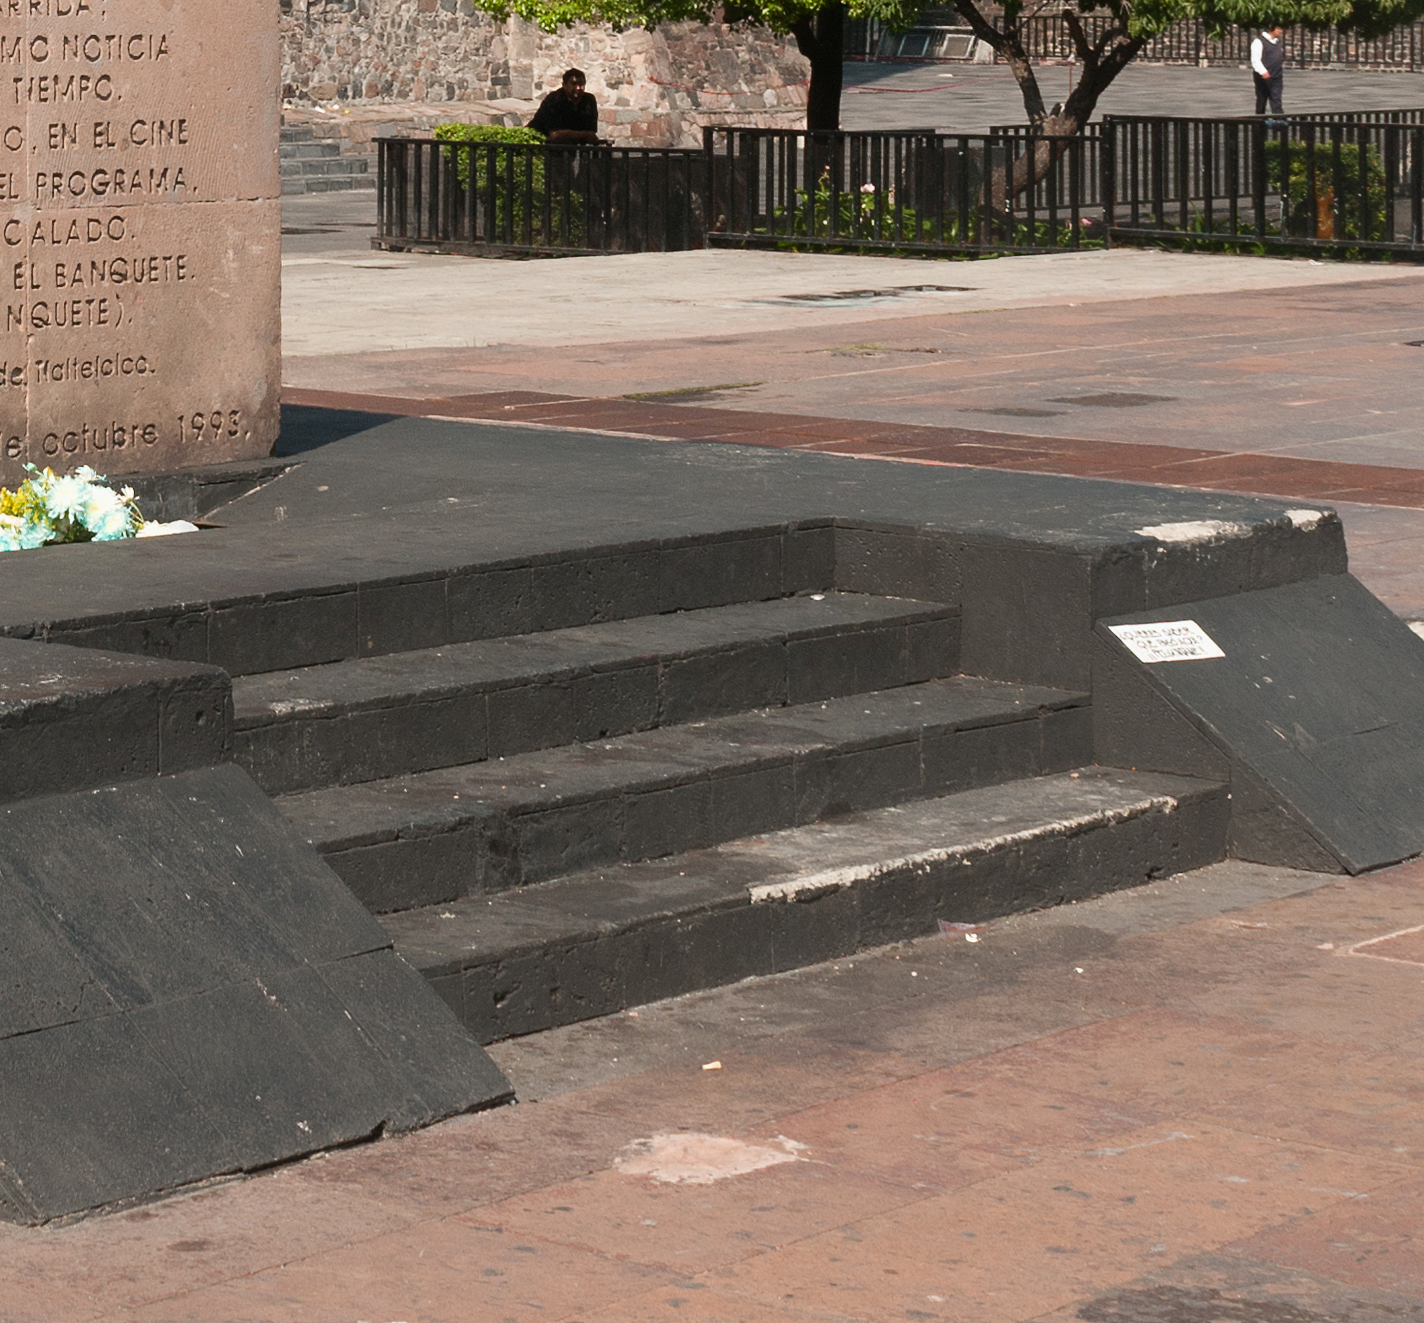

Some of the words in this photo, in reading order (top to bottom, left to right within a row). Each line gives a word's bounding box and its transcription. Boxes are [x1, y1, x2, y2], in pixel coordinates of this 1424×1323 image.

[62, 33, 171, 62] NOTICIA
[48, 120, 78, 150] EN
[92, 118, 116, 148] EL
[129, 116, 189, 147] CINE
[12, 261, 42, 292] EL
[40, 413, 159, 457] octubre
